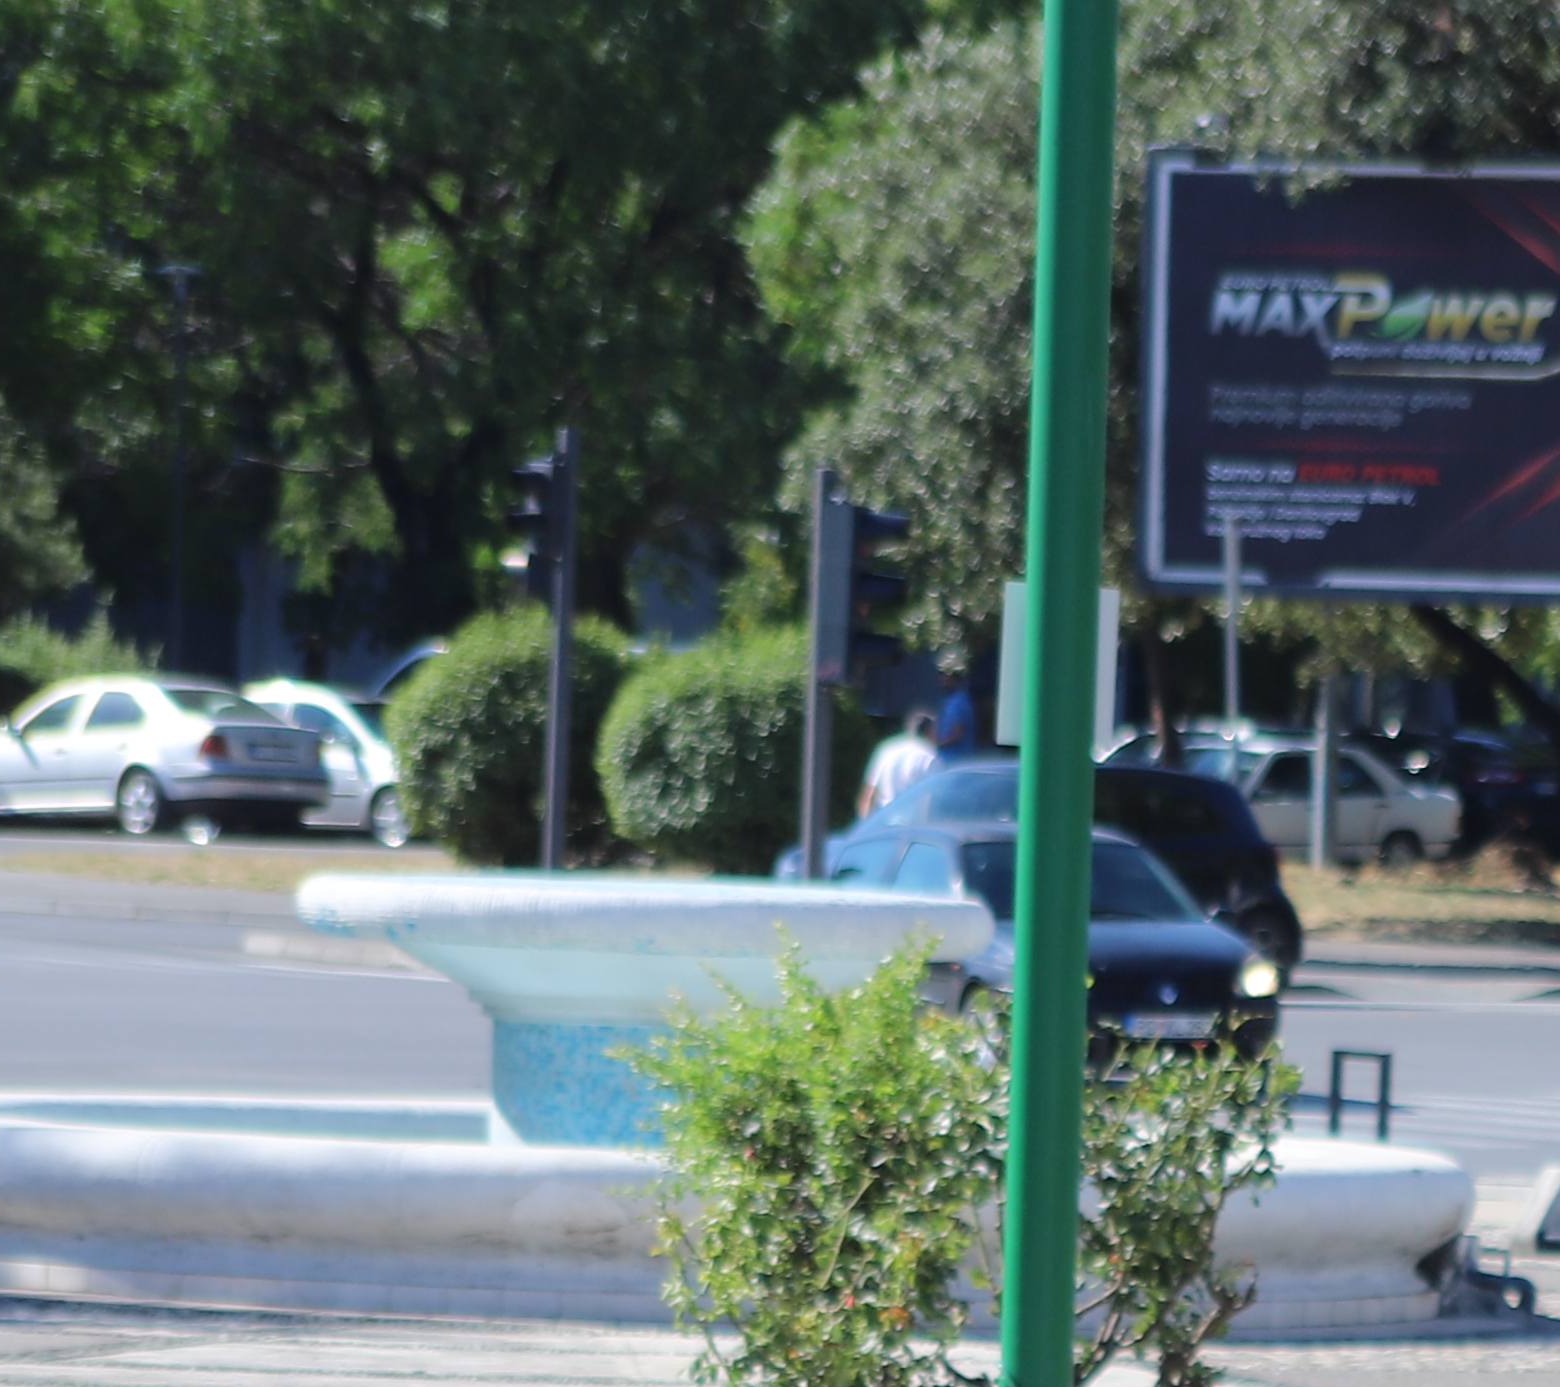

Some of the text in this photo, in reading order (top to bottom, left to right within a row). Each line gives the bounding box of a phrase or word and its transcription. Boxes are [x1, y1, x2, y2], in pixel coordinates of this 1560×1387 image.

[1206, 463, 1439, 486] Samo na EURO PETROL
